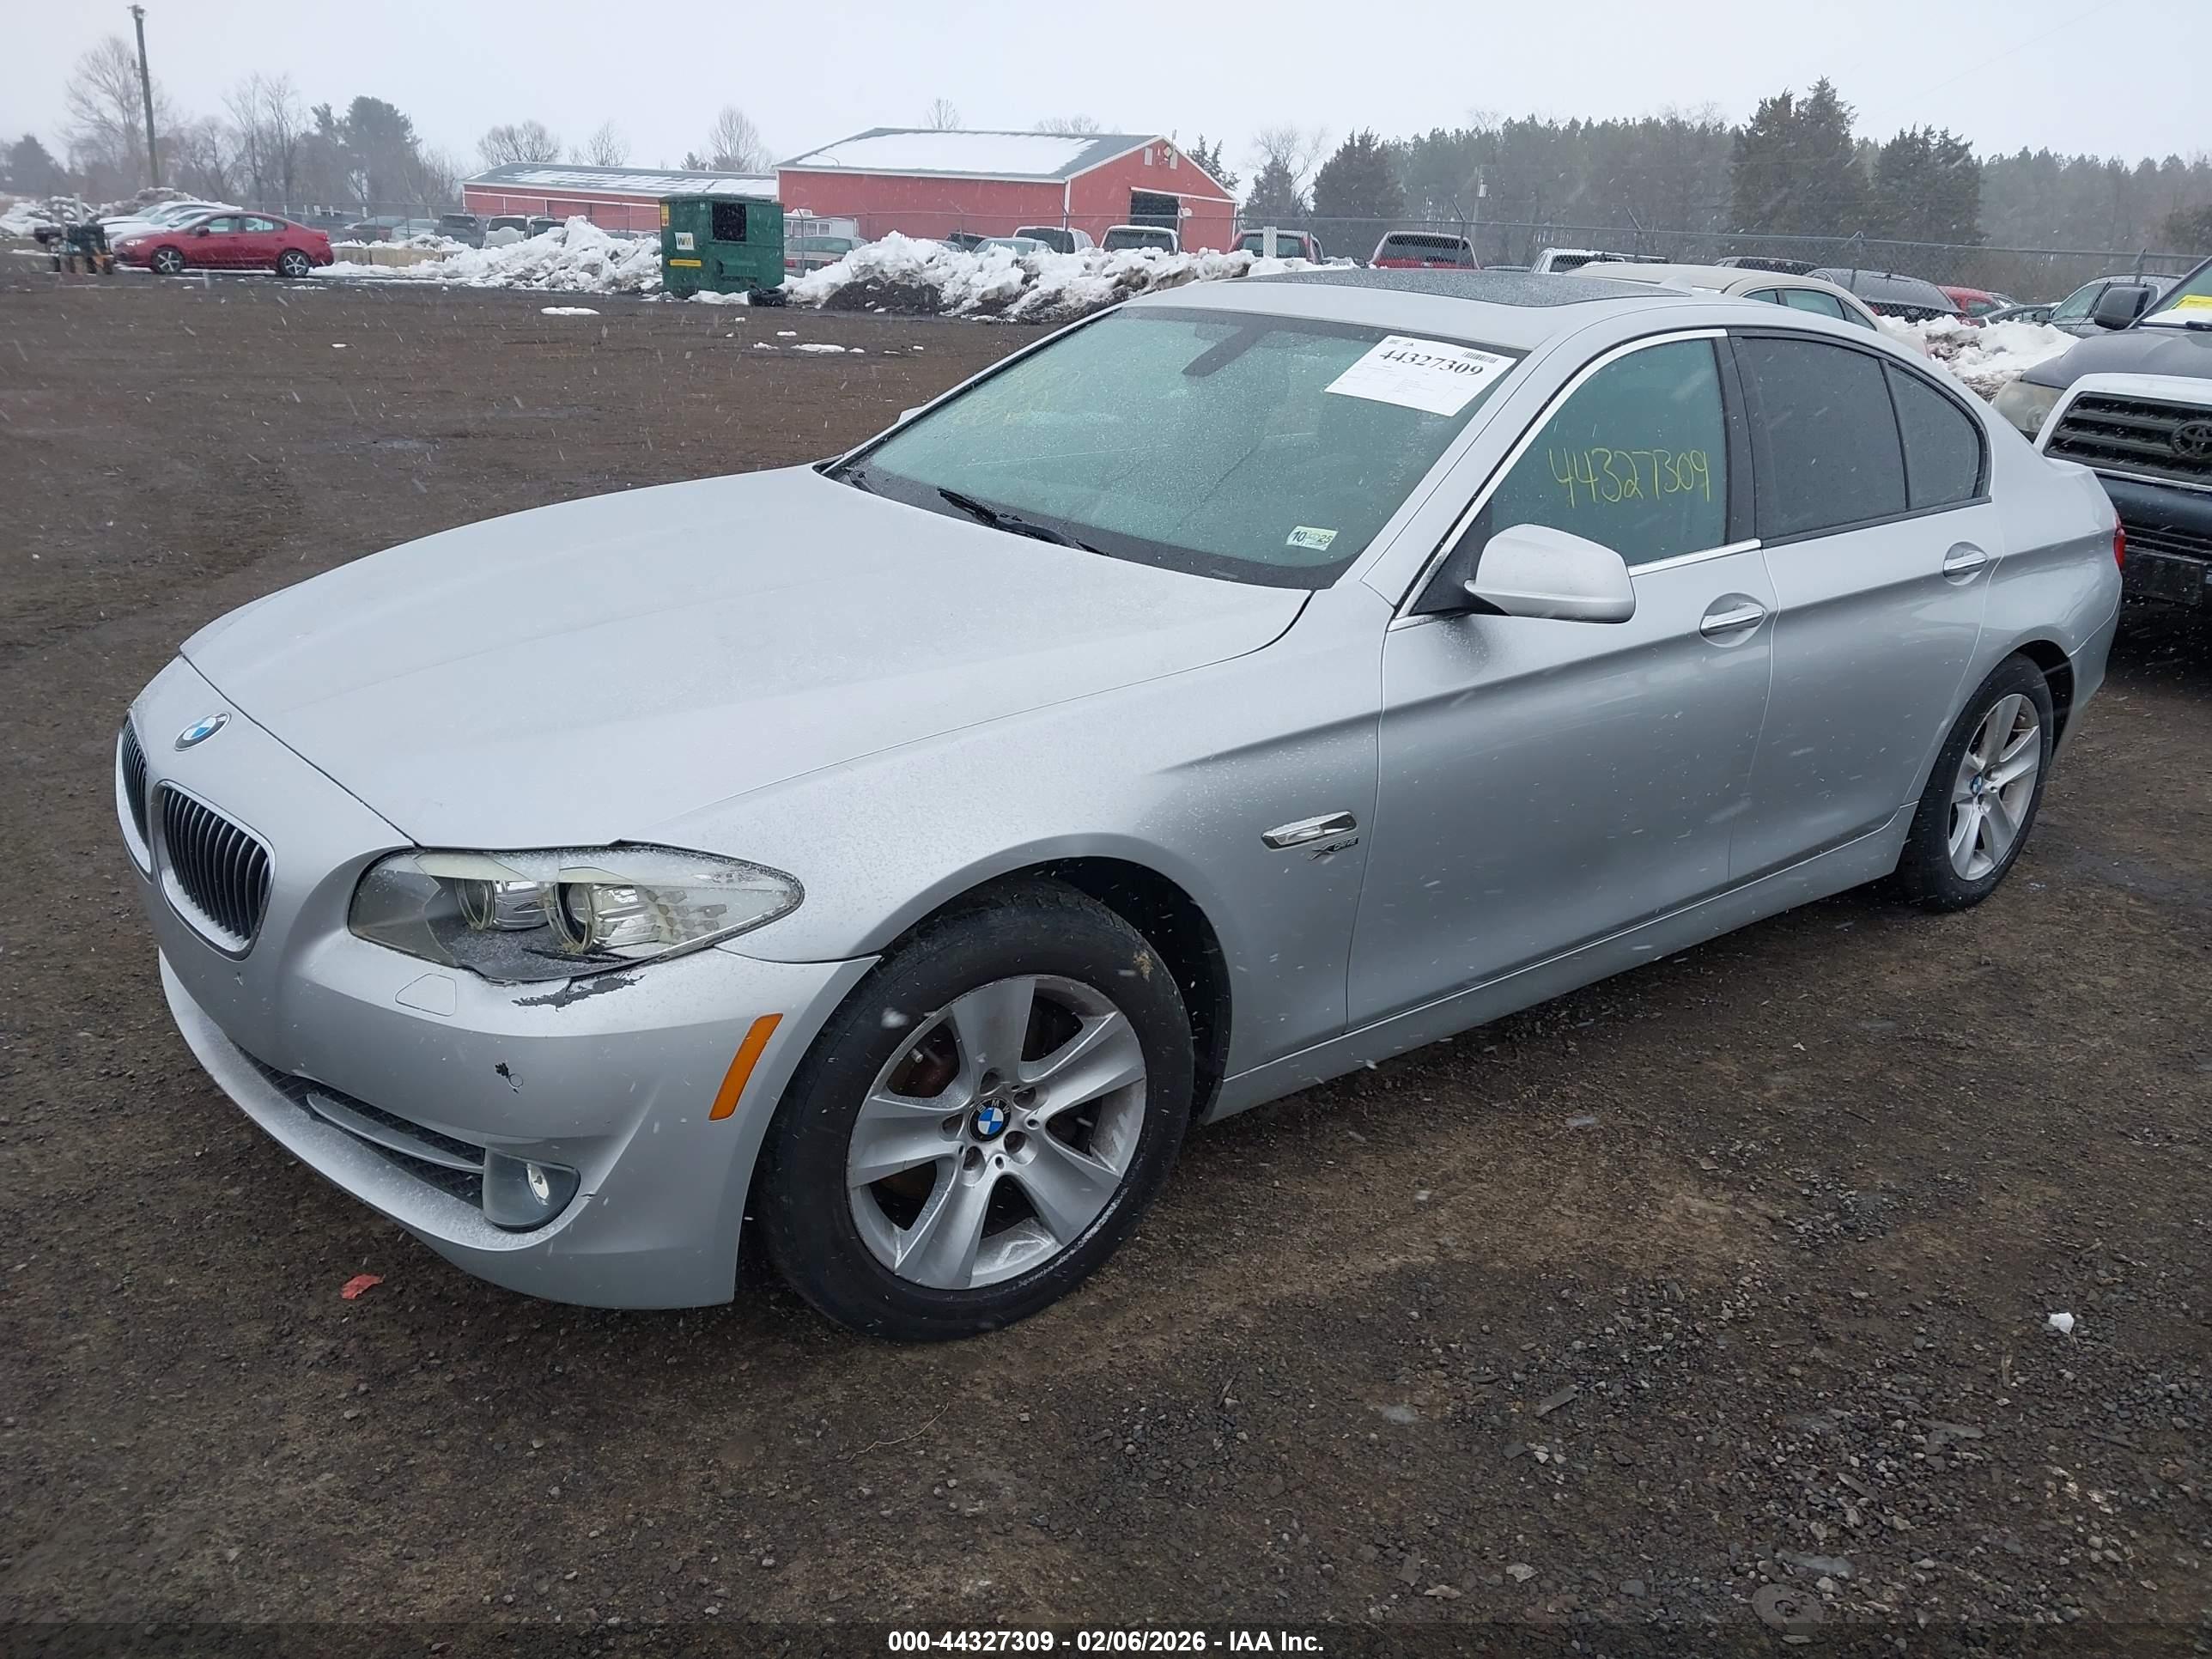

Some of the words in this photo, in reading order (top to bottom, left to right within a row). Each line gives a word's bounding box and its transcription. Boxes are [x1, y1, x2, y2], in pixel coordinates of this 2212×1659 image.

[1380, 349, 1484, 376] 44327309
[1548, 447, 1710, 508] 44327309
[1292, 531, 1308, 542] 10
[976, 1098, 1011, 1115] BMW
